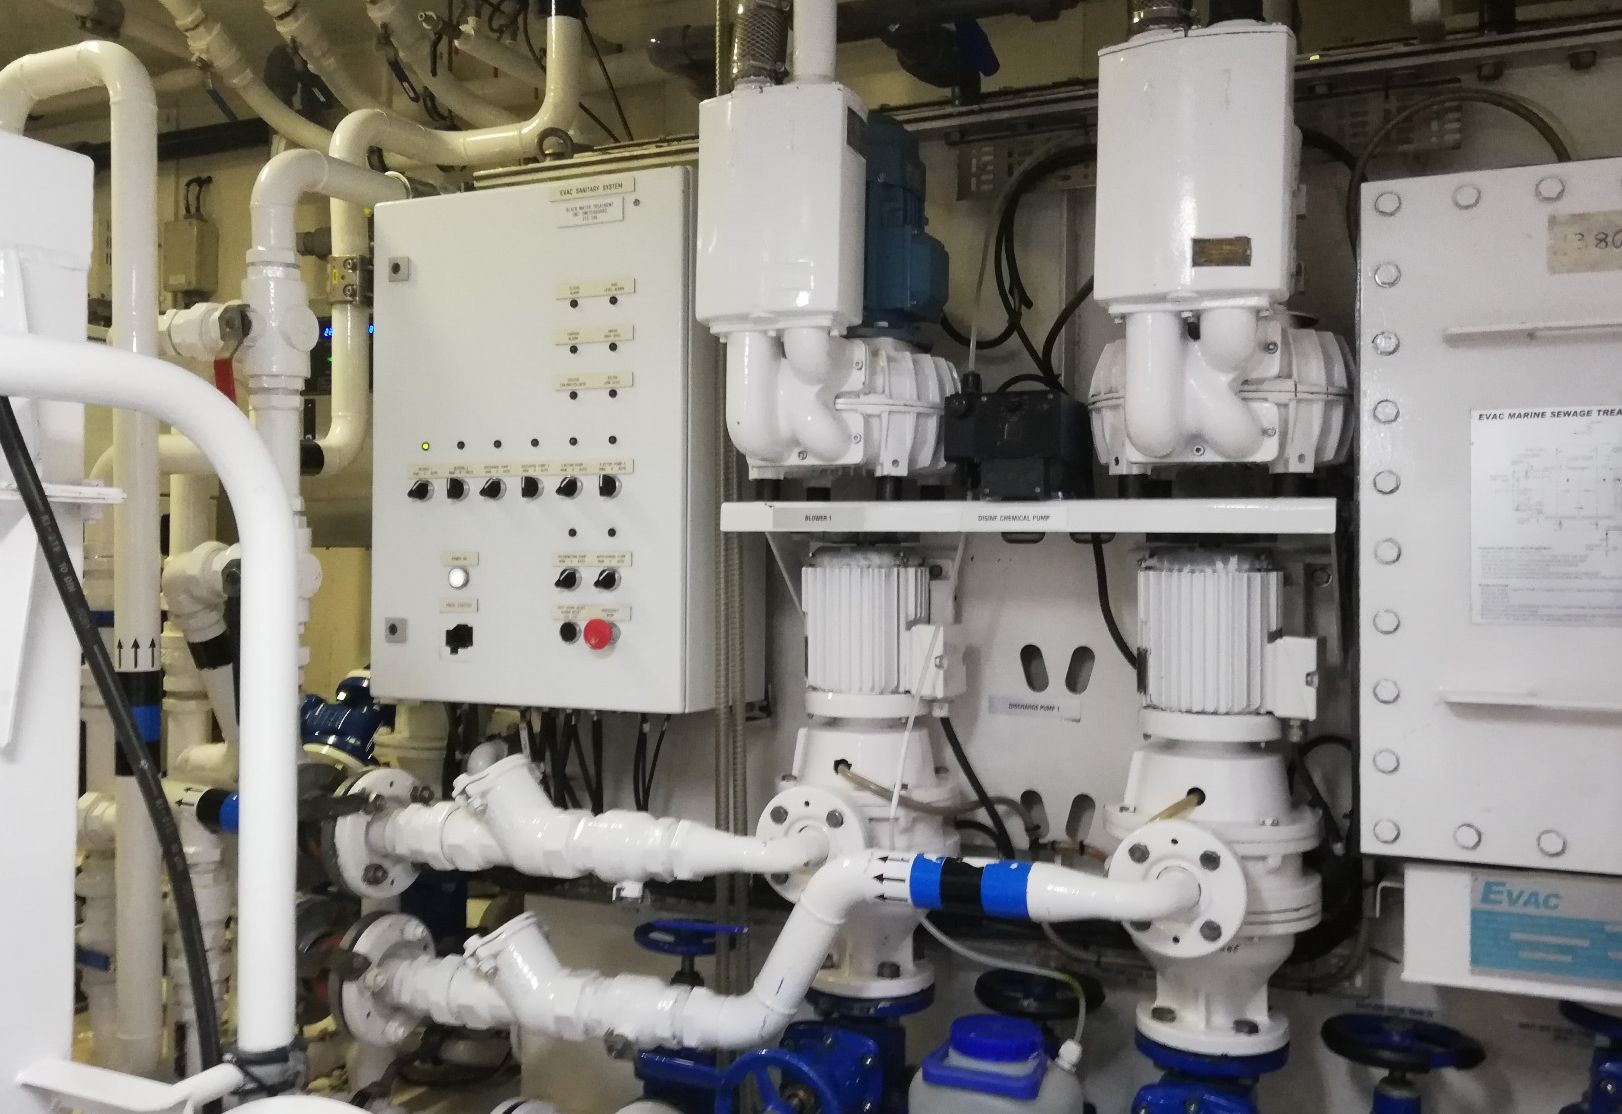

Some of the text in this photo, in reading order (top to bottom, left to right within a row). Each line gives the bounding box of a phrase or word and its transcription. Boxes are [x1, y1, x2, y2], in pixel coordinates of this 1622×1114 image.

[560, 181, 623, 196] EVAC SANITARY SYSTEM
[1478, 412, 1504, 421] EVAC
[1507, 411, 1547, 420] MARINE
[1550, 409, 1593, 418] SEWAGE
